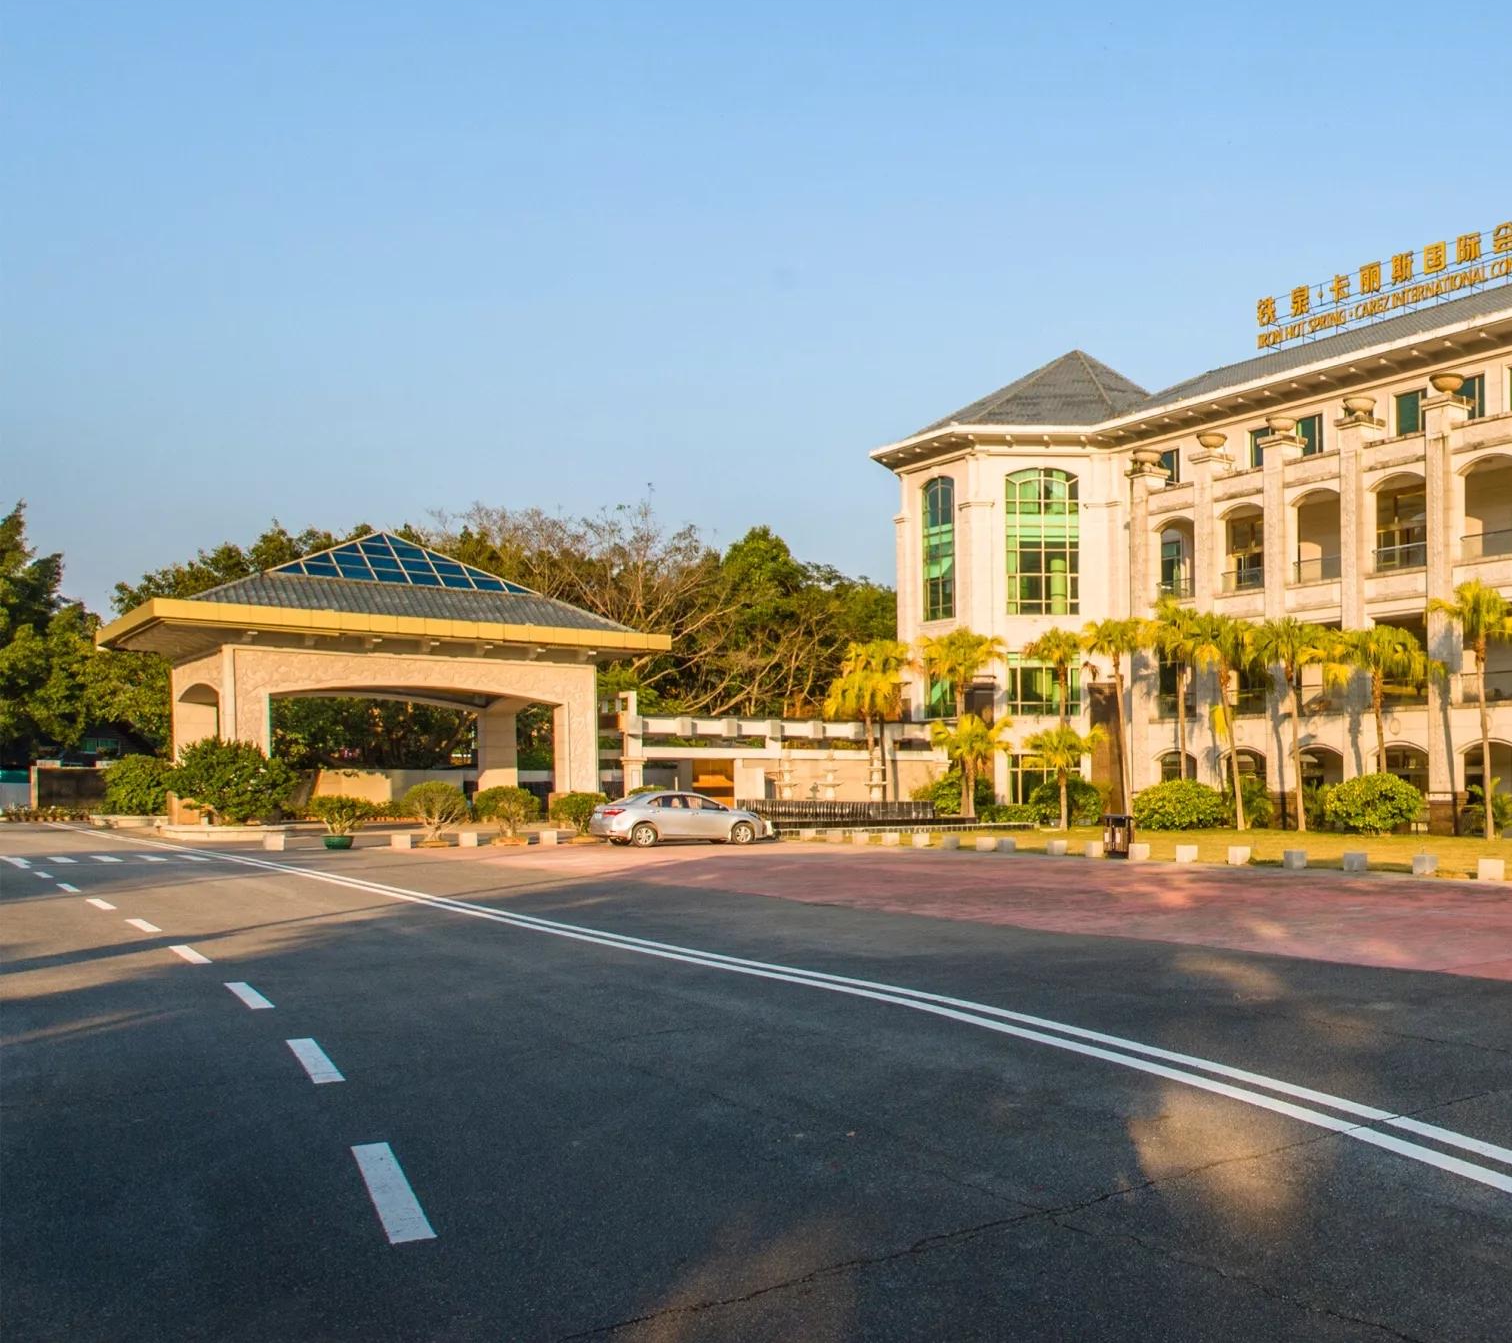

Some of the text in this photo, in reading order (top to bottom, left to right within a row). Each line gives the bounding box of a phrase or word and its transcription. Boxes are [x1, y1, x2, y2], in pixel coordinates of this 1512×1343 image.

[1257, 327, 1284, 349] IRON
[1285, 321, 1305, 340] HOT
[1308, 309, 1346, 333] SPRING
[1354, 297, 1390, 319] CAREZ
[1392, 264, 1488, 309] INTERNATIONAL
